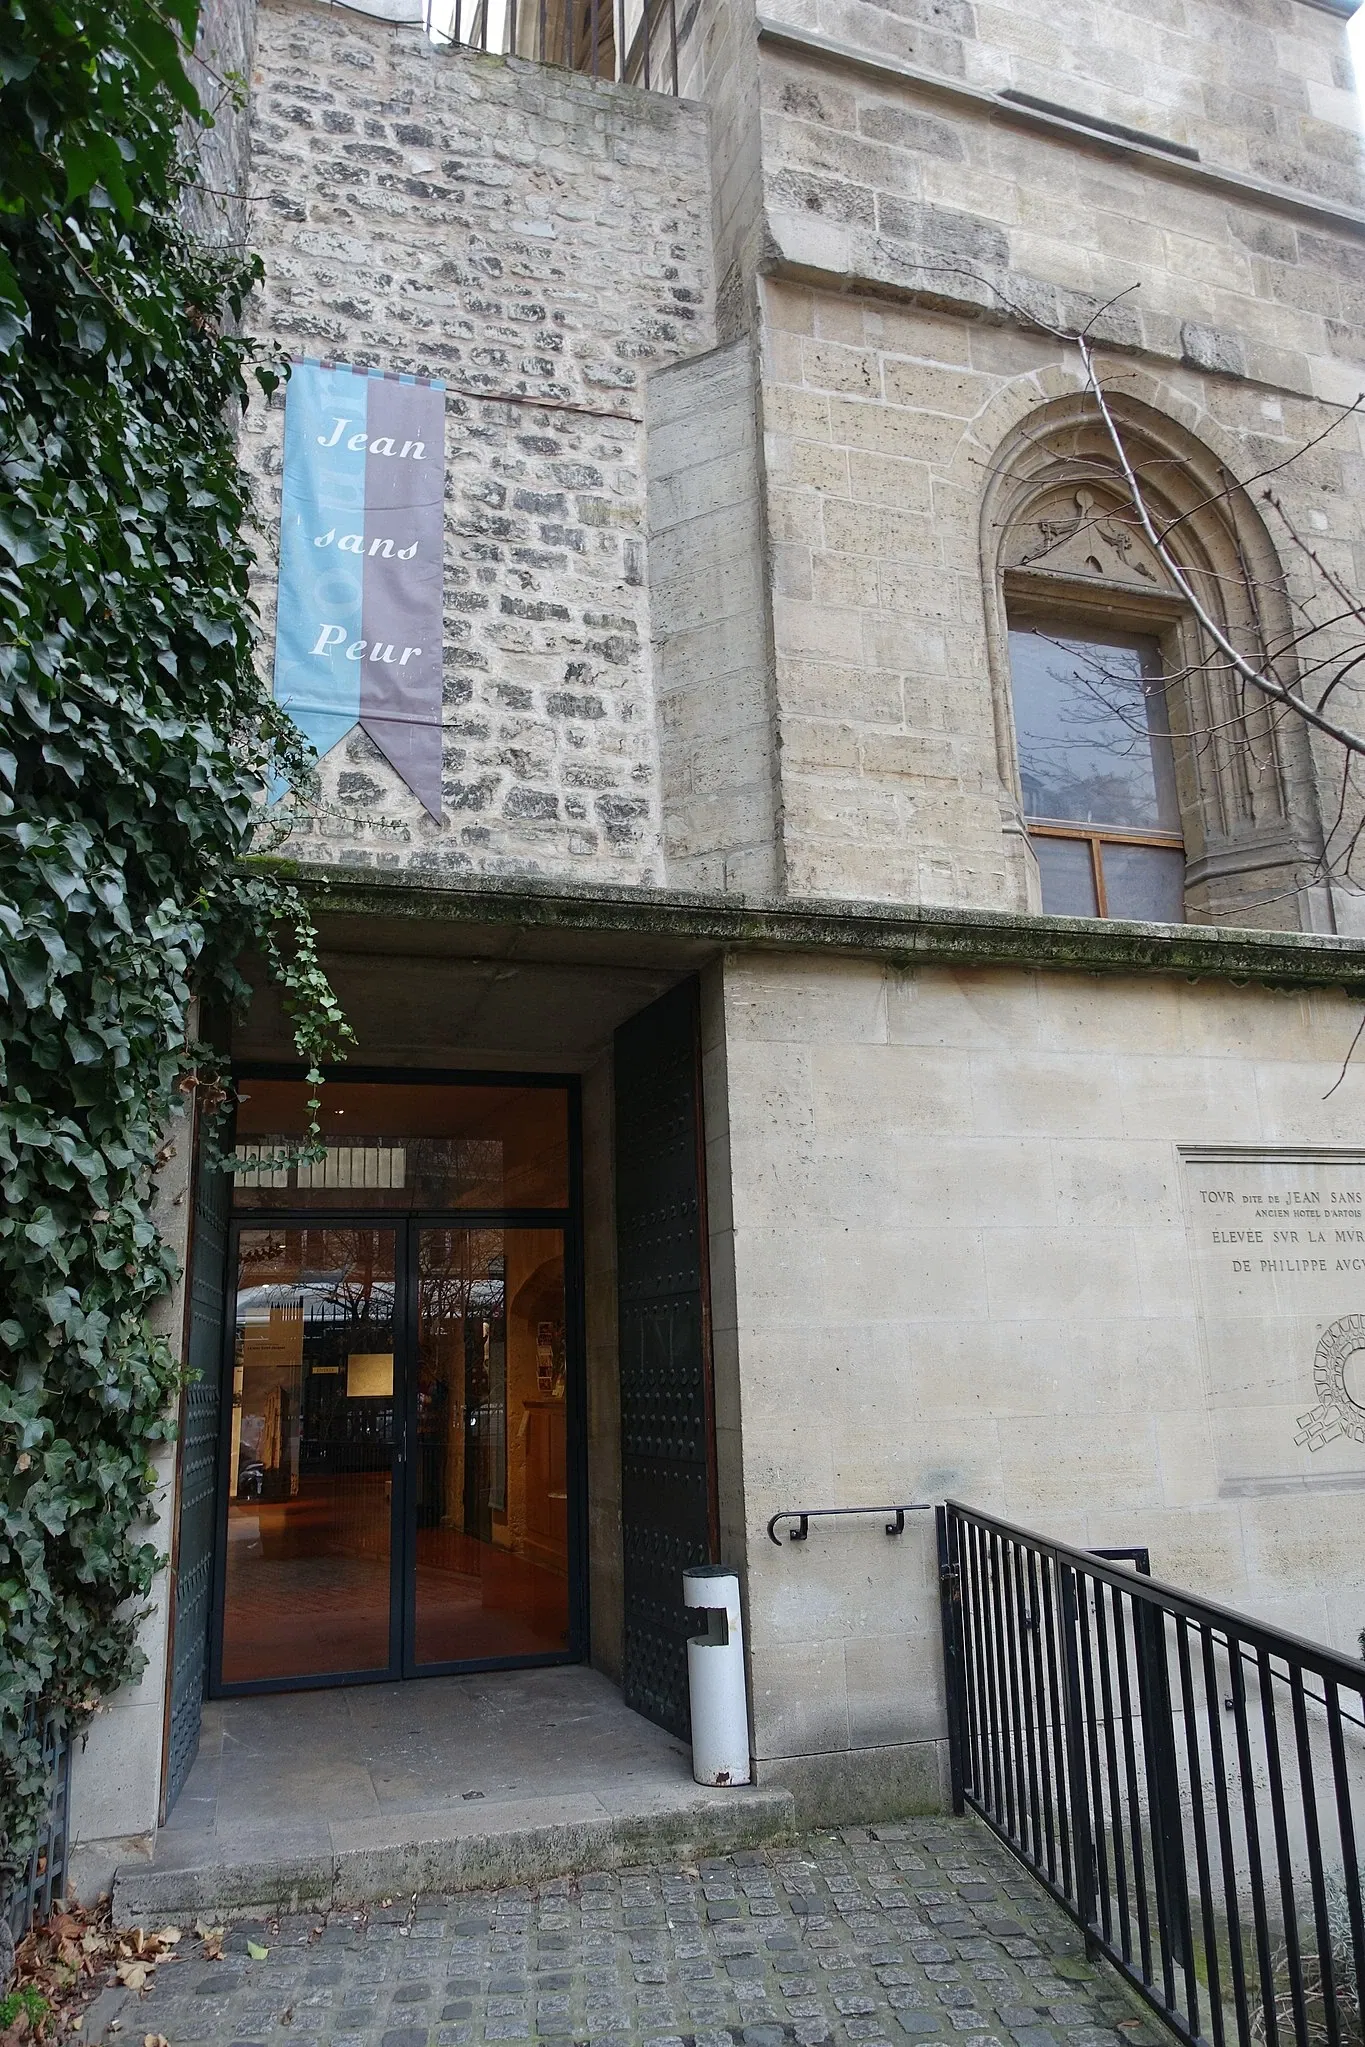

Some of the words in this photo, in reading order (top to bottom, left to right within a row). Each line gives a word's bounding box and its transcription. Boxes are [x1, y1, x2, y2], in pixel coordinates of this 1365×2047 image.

[316, 417, 428, 460] Jean
[313, 527, 419, 560] sans
[307, 622, 422, 666] Peur
[1200, 1190, 1236, 1204] TOVR
[1242, 1195, 1263, 1204] DITE
[1268, 1195, 1280, 1204] DE
[1286, 1191, 1321, 1206] JEAN
[1330, 1191, 1362, 1204] SANS
[1255, 1209, 1290, 1218] ANCIEN
[1324, 1209, 1362, 1218] D'ARTOIS
[1273, 1231, 1300, 1243] SVR
[1308, 1231, 1326, 1243] LA
[1232, 1260, 1252, 1273] DE
[1260, 1260, 1327, 1272] PHILIPPE
